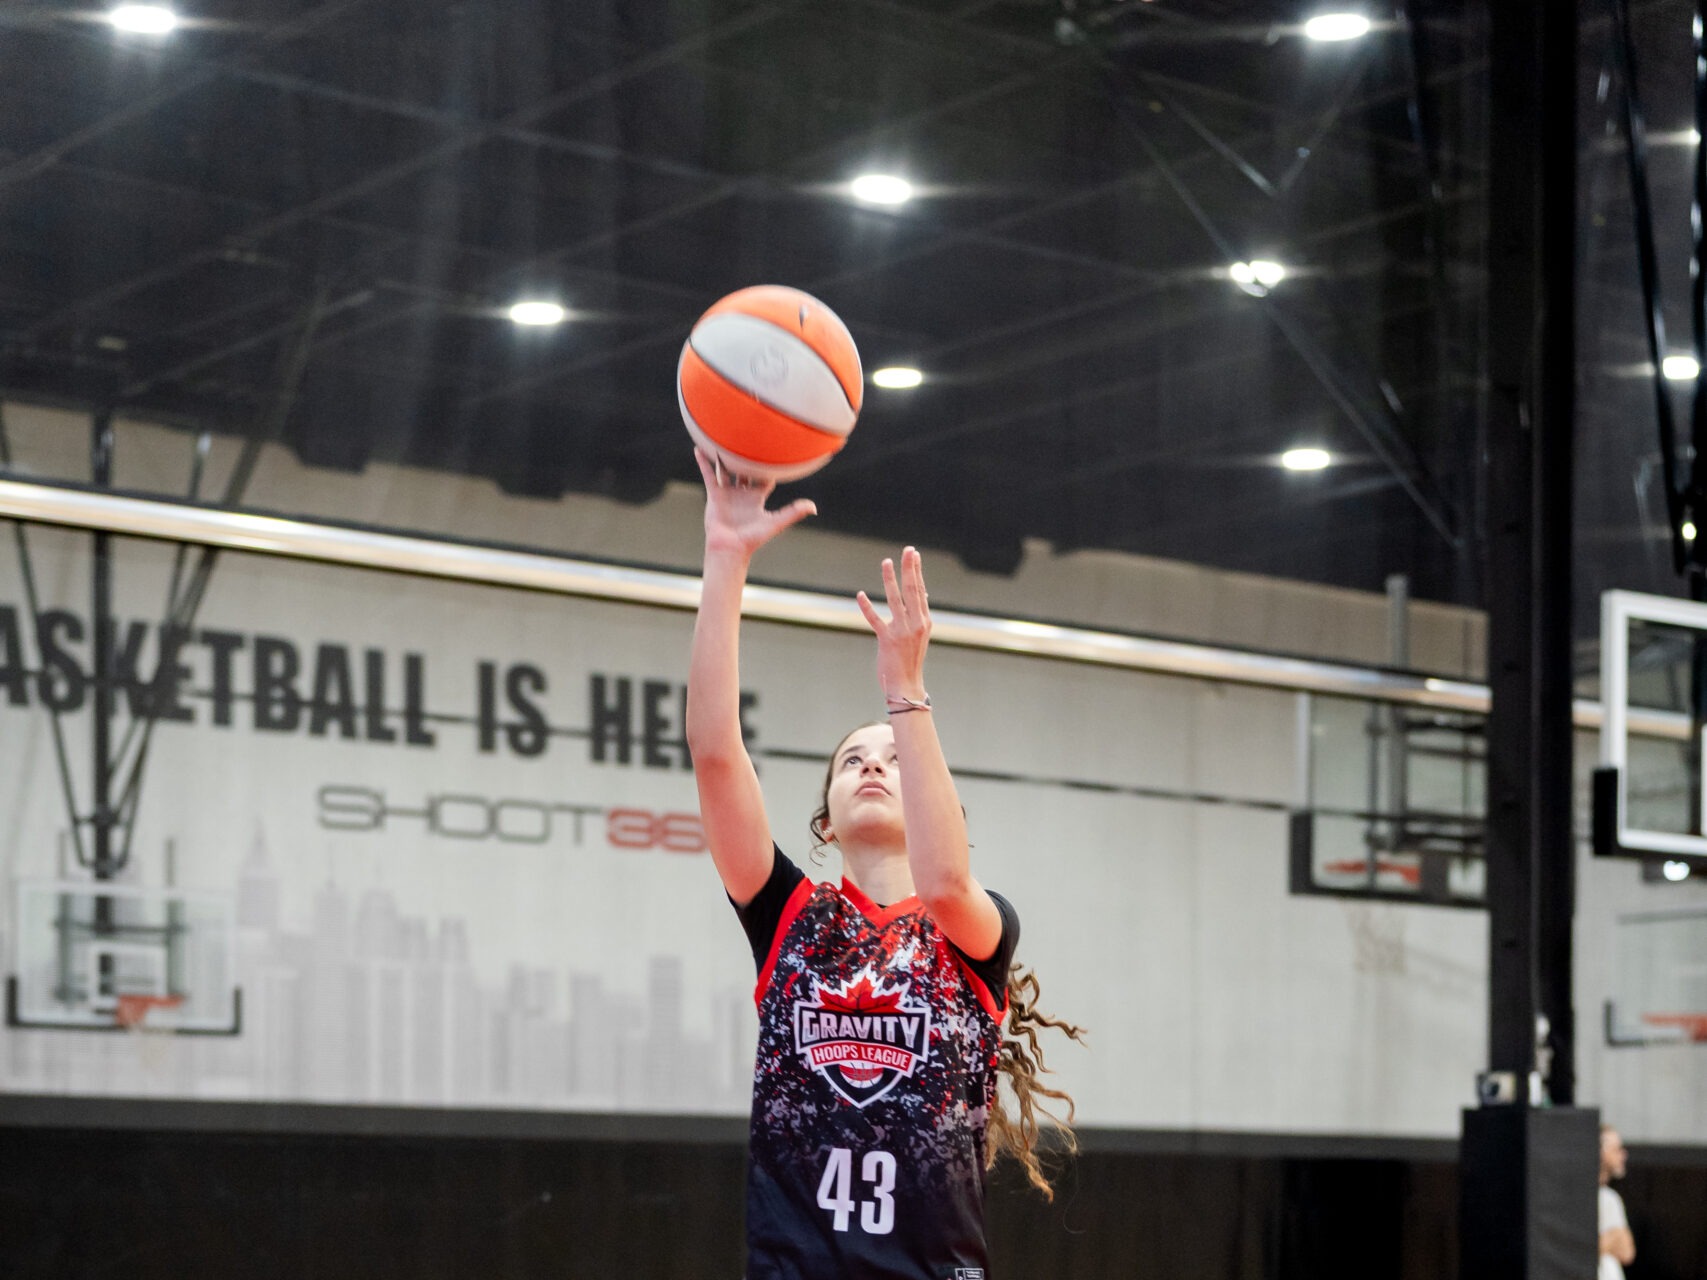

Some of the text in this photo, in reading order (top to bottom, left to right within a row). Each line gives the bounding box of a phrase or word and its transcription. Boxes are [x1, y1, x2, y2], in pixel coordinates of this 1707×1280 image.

[476, 659, 550, 759] IS
[801, 1010, 920, 1049] GRAVITY
[813, 1045, 910, 1069] HOOPS LEAGUE
[816, 1147, 897, 1235] 43
